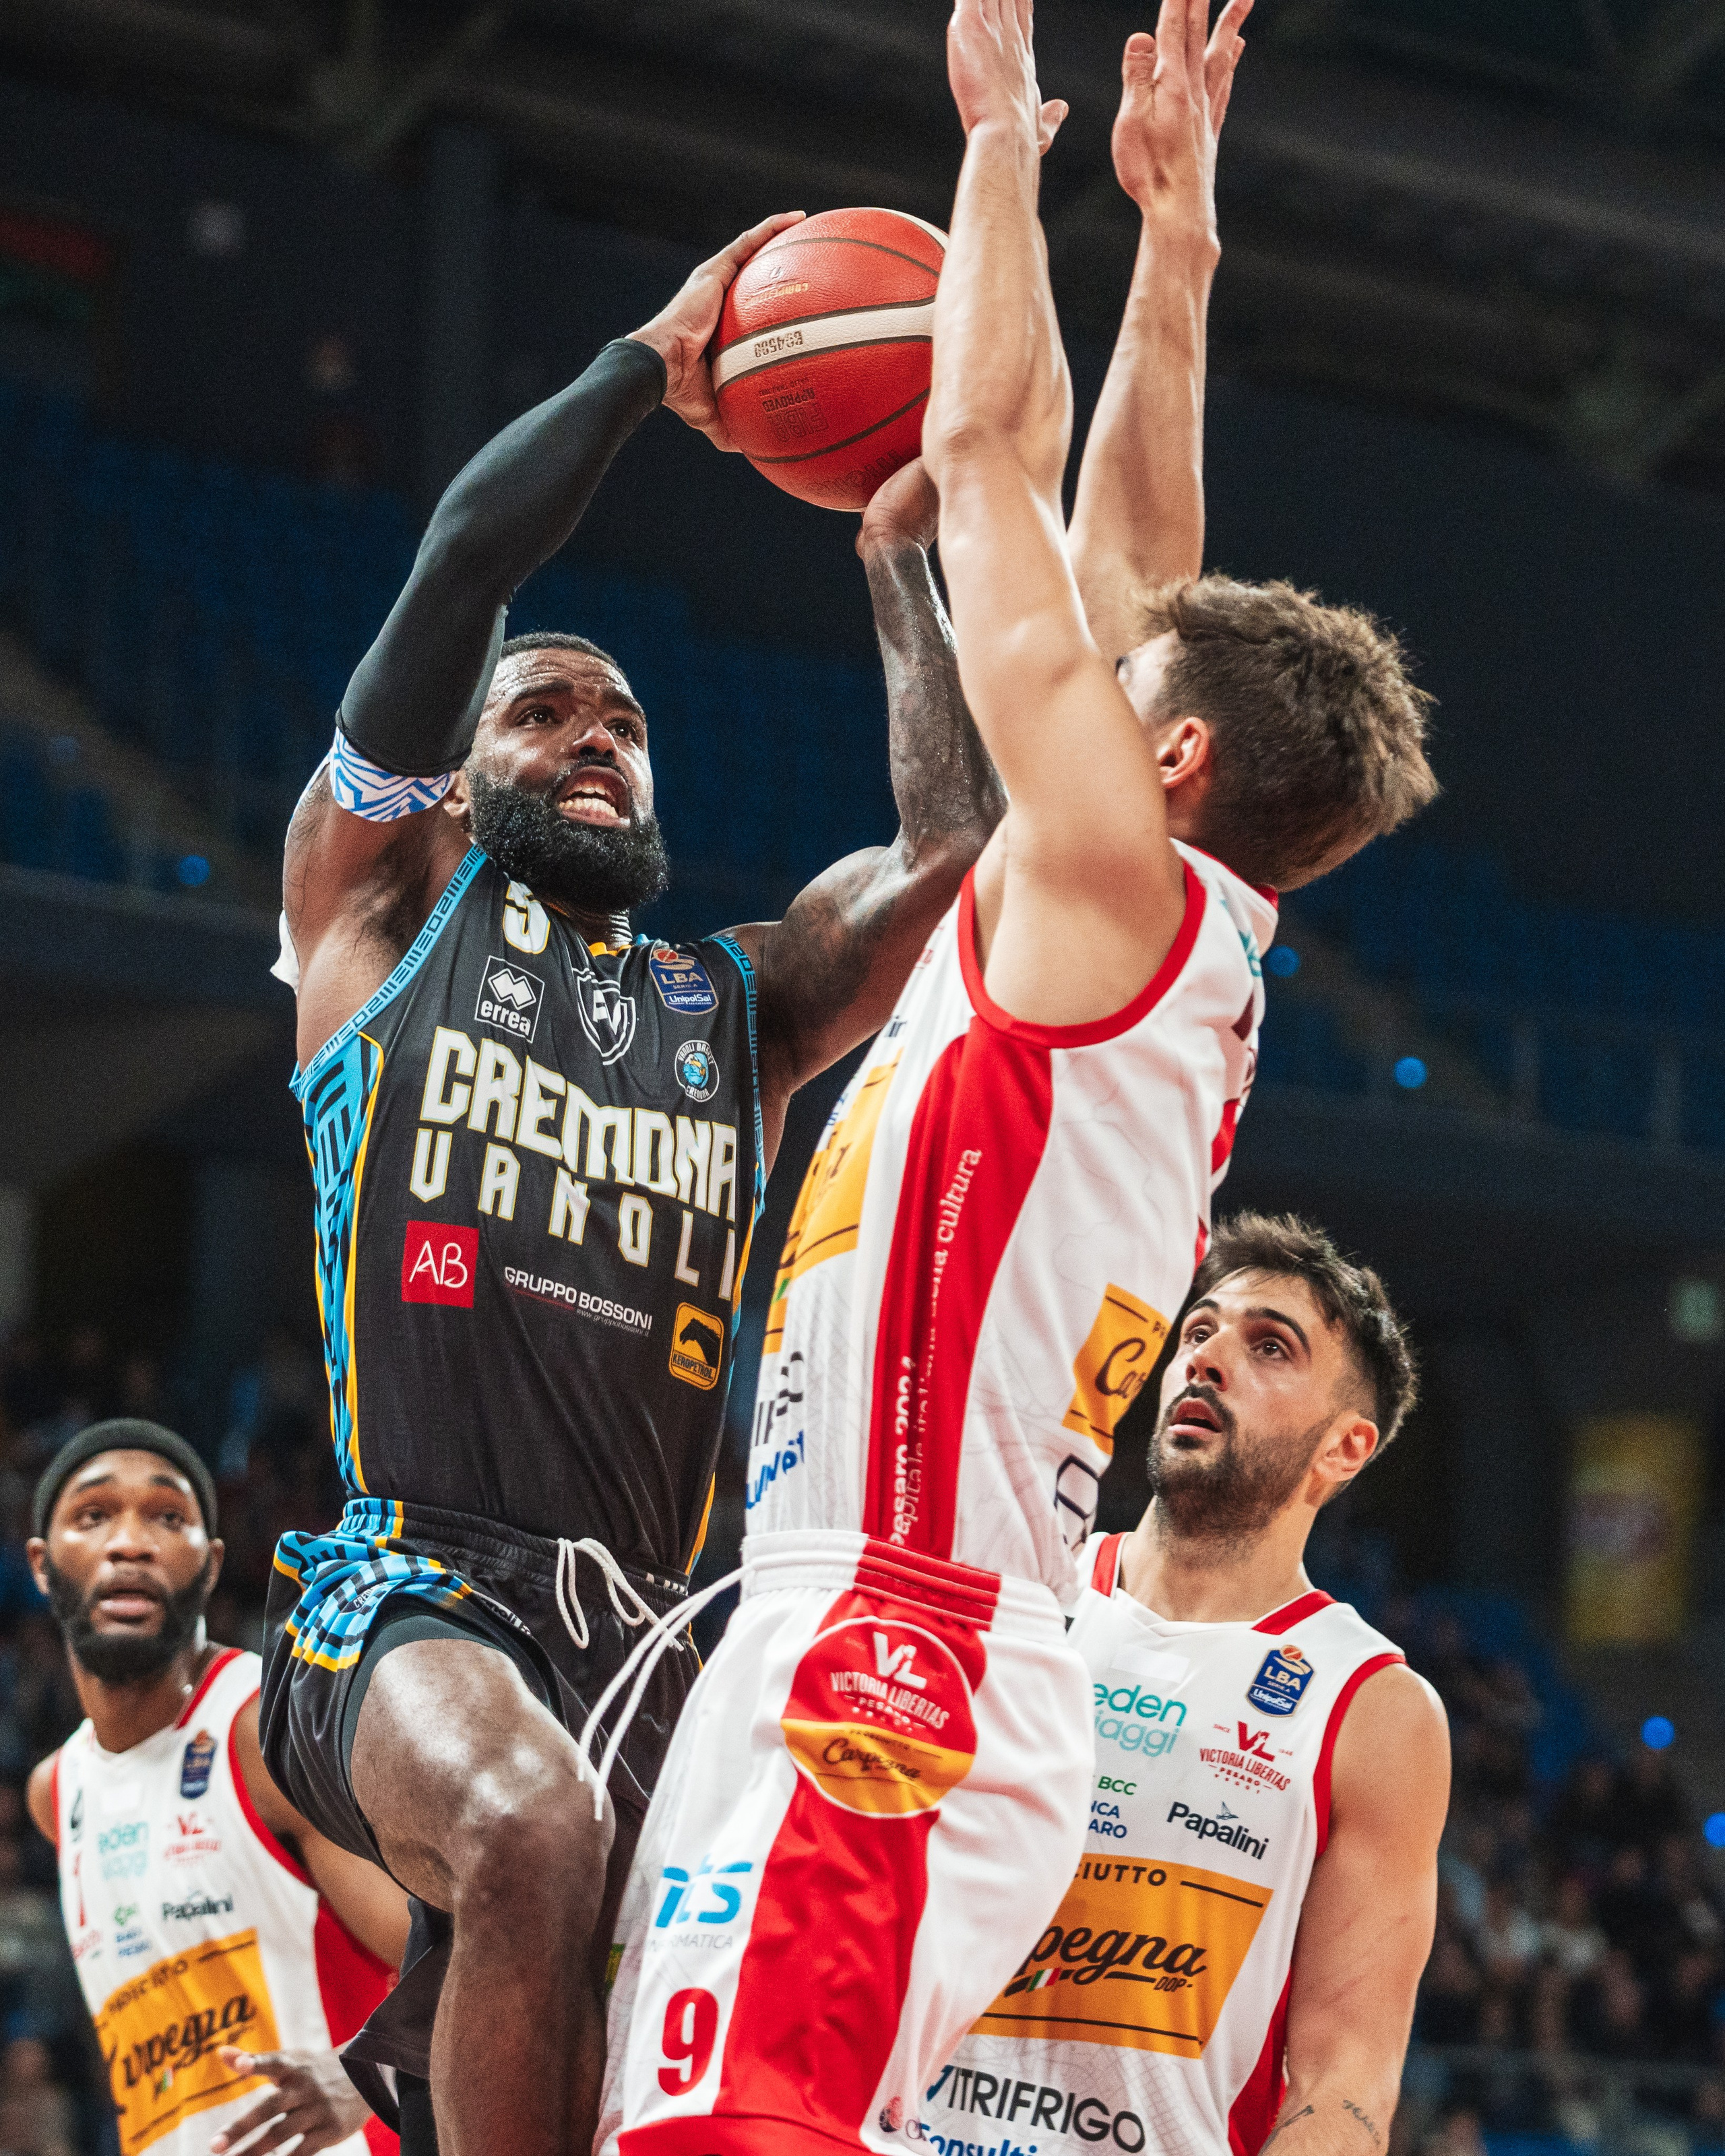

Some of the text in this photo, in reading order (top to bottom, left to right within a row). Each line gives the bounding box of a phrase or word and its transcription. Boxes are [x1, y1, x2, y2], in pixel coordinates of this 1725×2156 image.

[762, 387, 815, 412] APPROVED
[660, 972, 703, 985] LBA
[677, 1042, 695, 1062] VANOLI
[686, 1085, 710, 1100] CREMONA
[420, 1025, 738, 1222] CREMONA
[937, 1148, 982, 1243] cultura
[409, 1240, 468, 1288] AB
[504, 1266, 653, 1331] GRUPPO BOSSONI
[830, 1672, 950, 1730] VICTORIA LIBERTAS
[1264, 1666, 1301, 1691] LBA
[1094, 1711, 1180, 1758] iaggi
[1098, 1776, 1137, 1796] BCC
[1199, 1748, 1291, 1791] VICTORIA LIBERTAS
[1088, 1818, 1127, 1839] ARO
[1166, 1801, 1270, 1861] Papalini
[1075, 1862, 1167, 1886] IUTTO
[1013, 1925, 1208, 1986] pegna
[658, 1987, 719, 2097] 9
